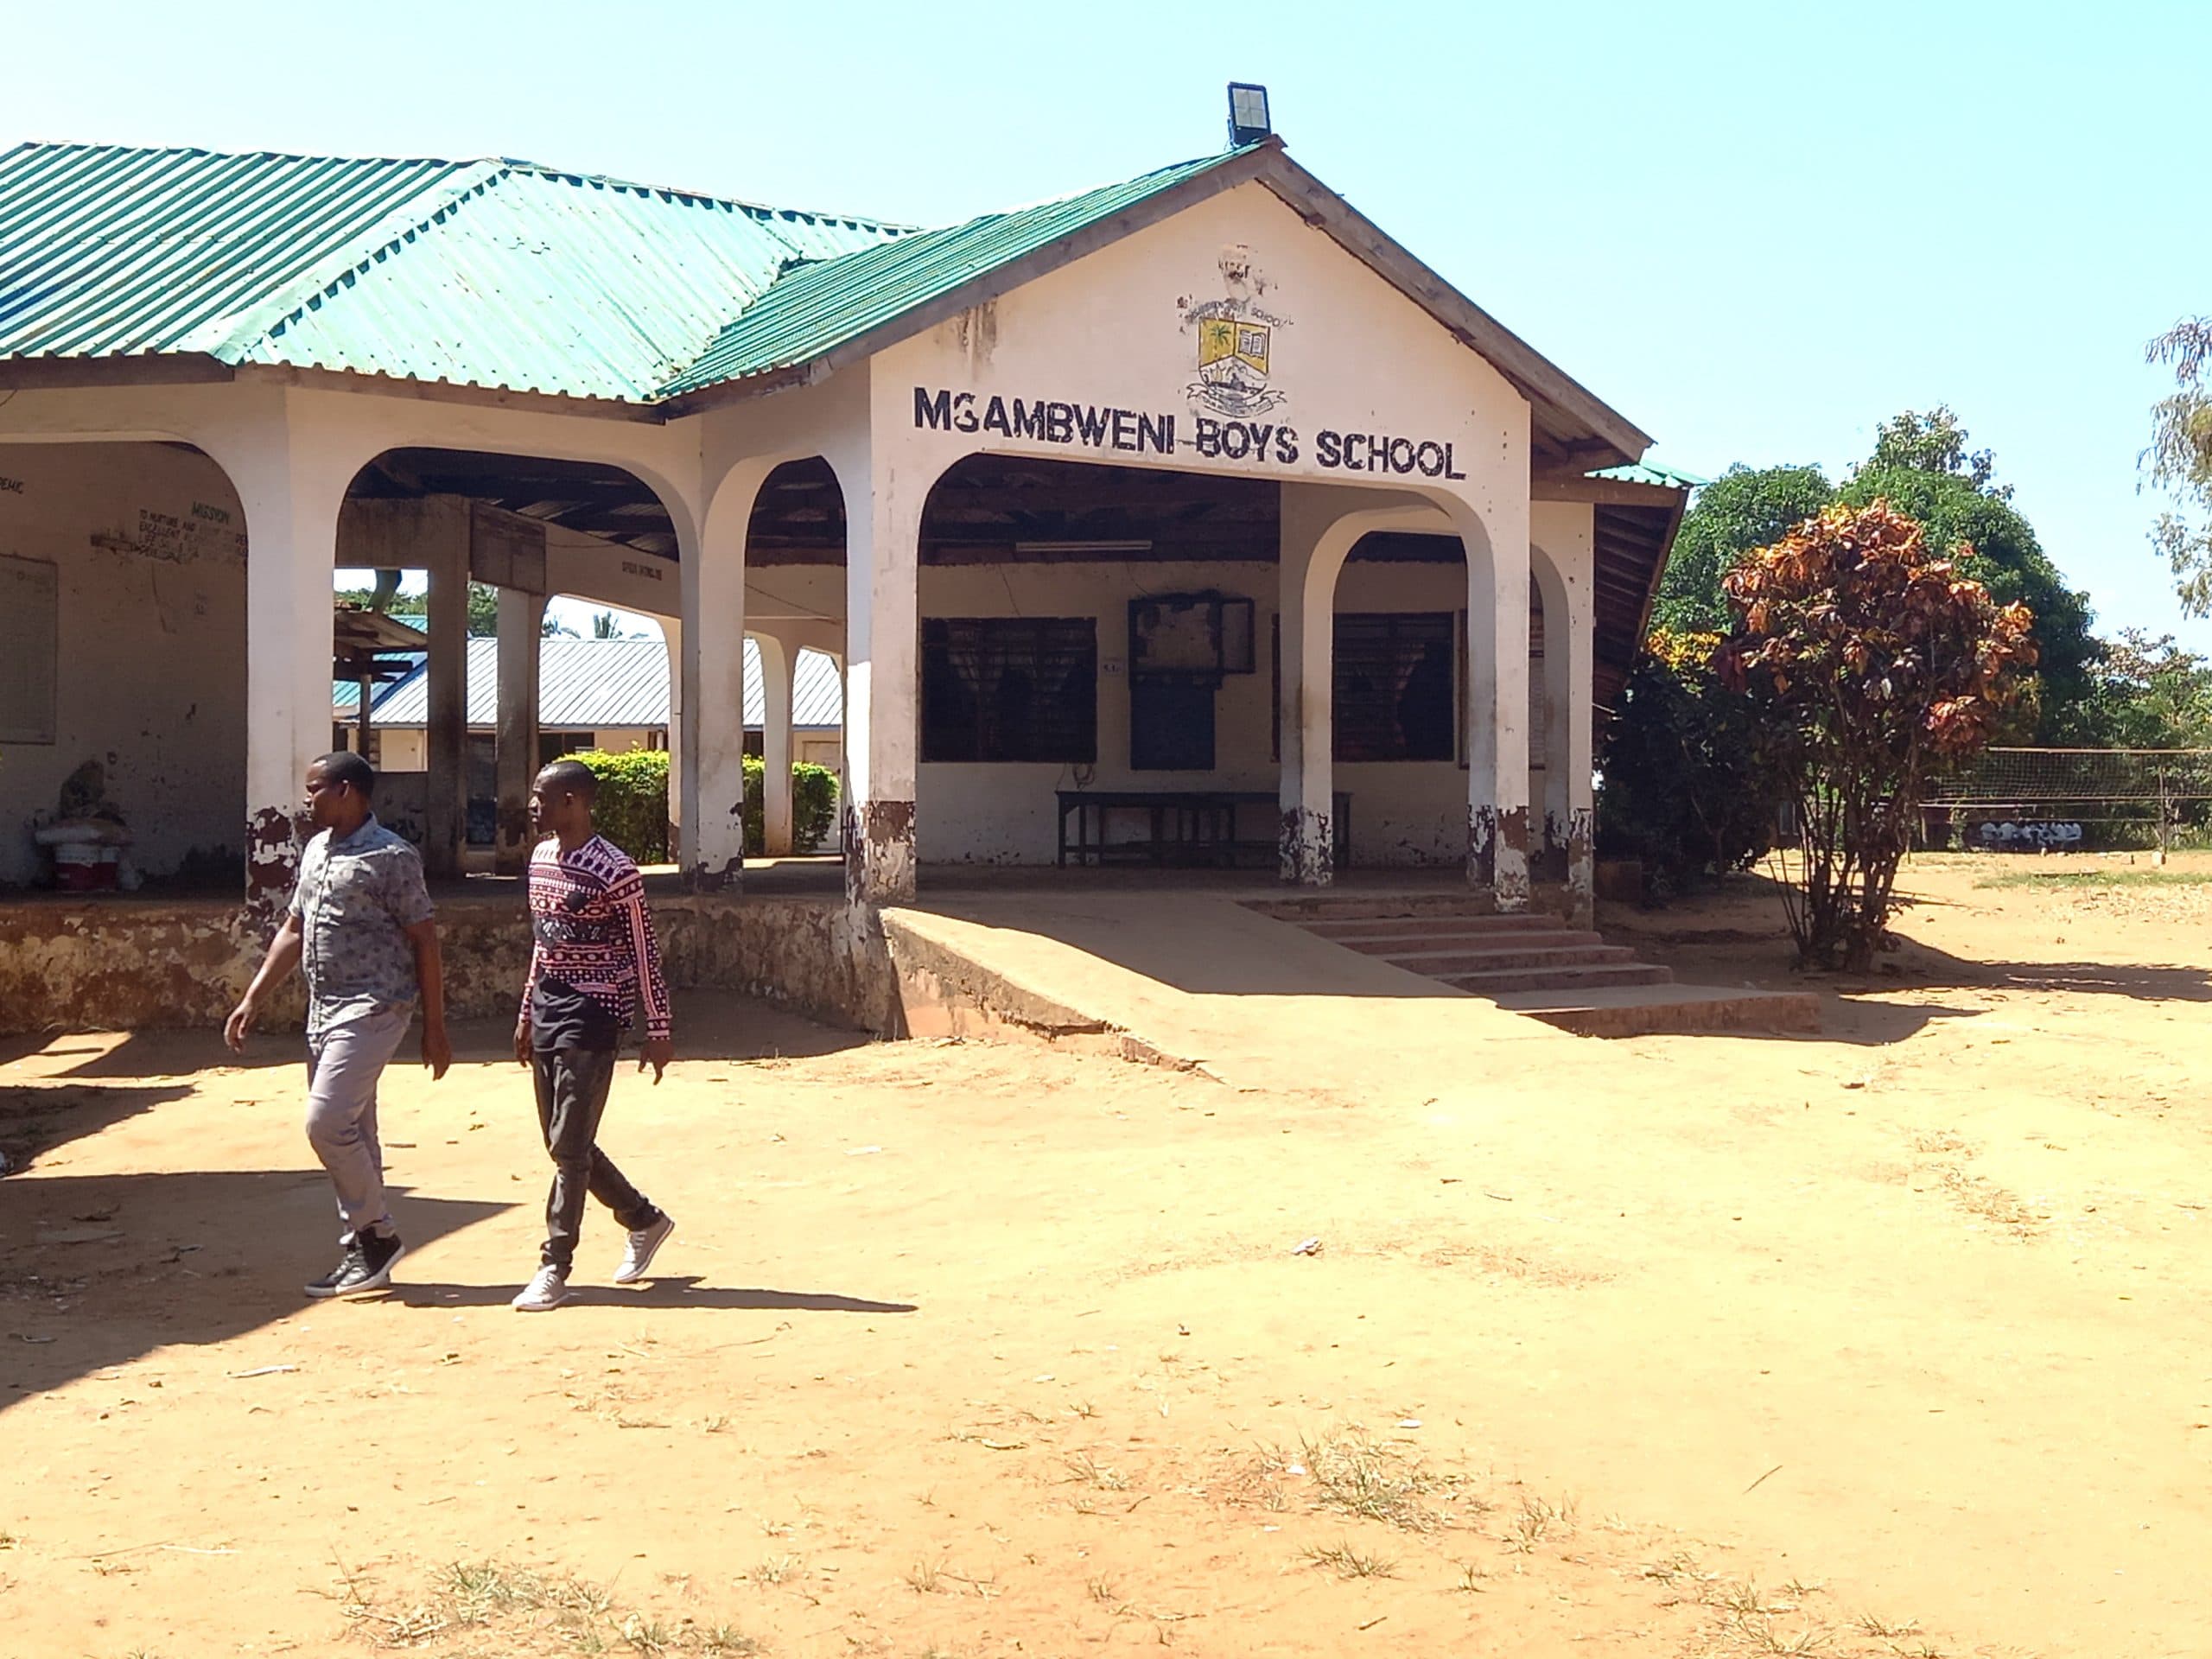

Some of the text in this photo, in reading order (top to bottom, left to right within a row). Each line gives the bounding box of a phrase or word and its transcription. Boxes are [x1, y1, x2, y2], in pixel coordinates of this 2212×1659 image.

[913, 386, 1466, 480] MSAMBWENI BOYS SCHOOL
